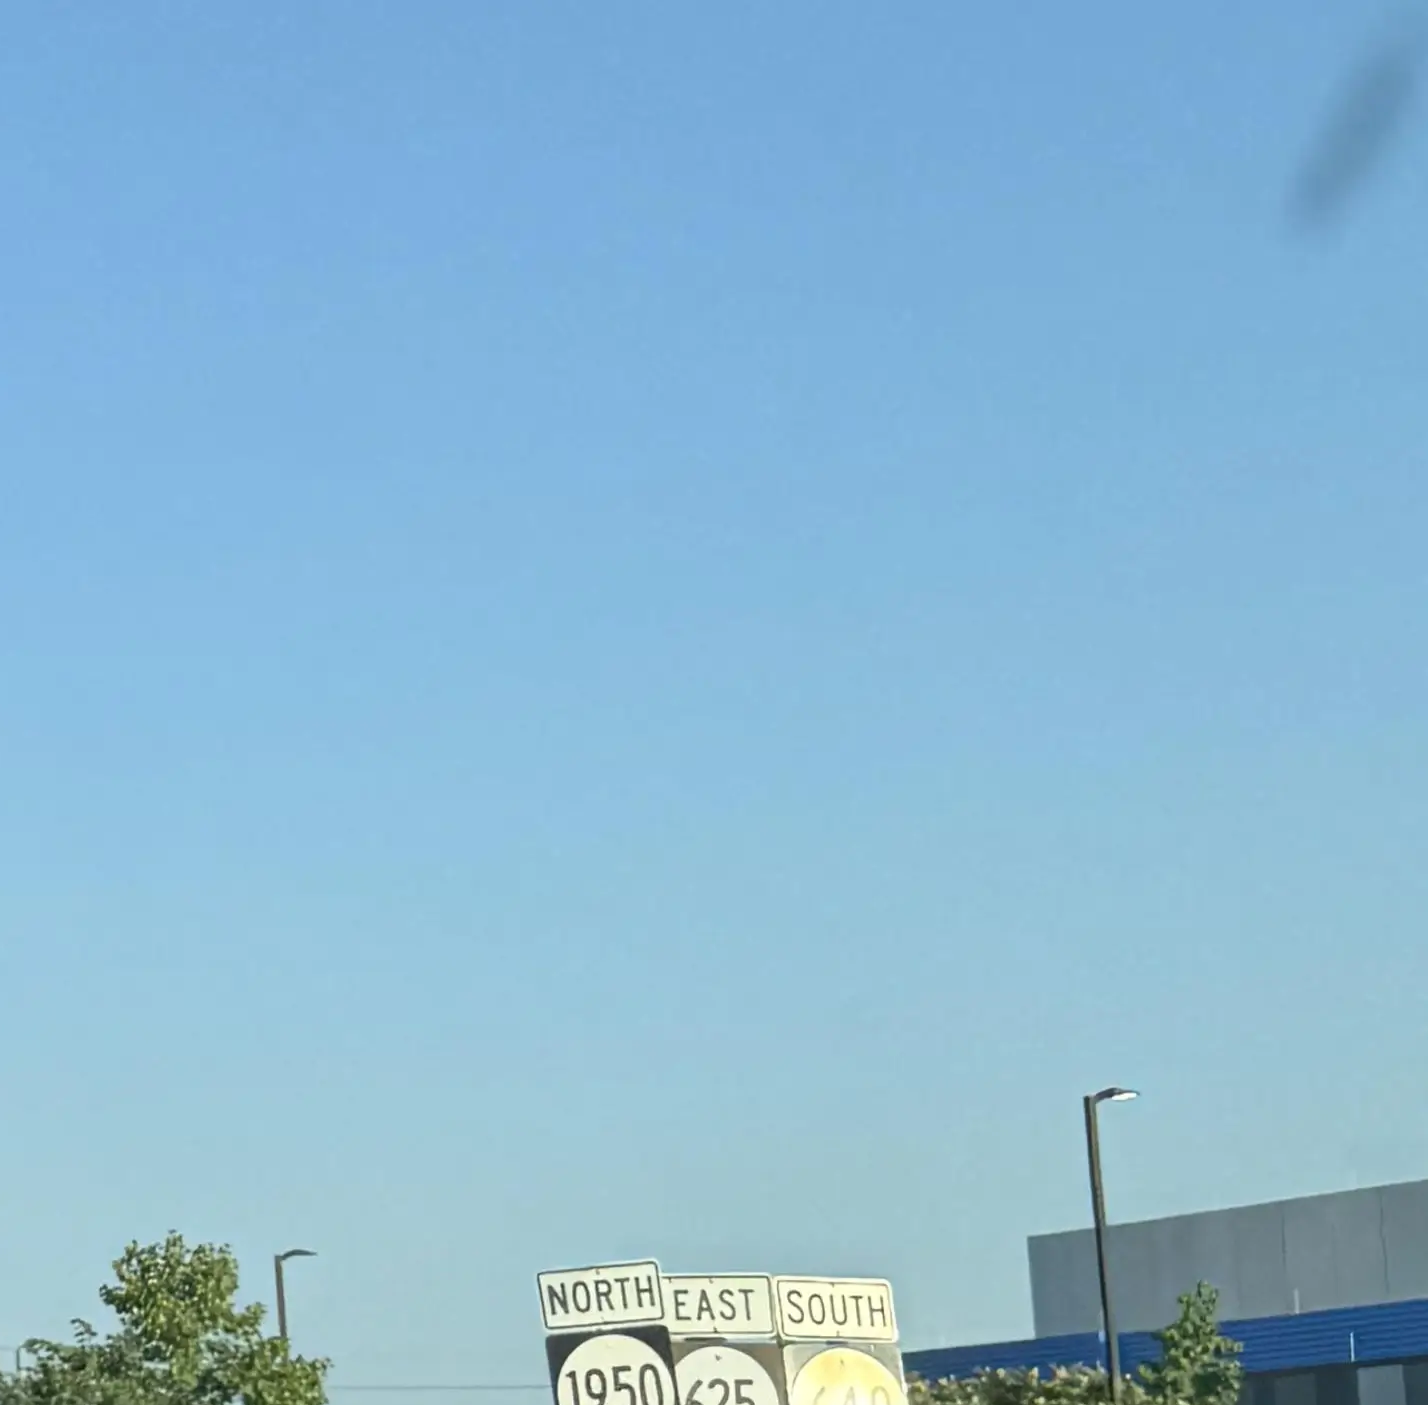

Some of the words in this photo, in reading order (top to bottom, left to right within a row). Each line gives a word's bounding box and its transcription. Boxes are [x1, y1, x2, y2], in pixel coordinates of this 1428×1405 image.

[547, 1276, 656, 1316] NORTH
[674, 1289, 755, 1321] EAST
[787, 1290, 886, 1327] SOUTH
